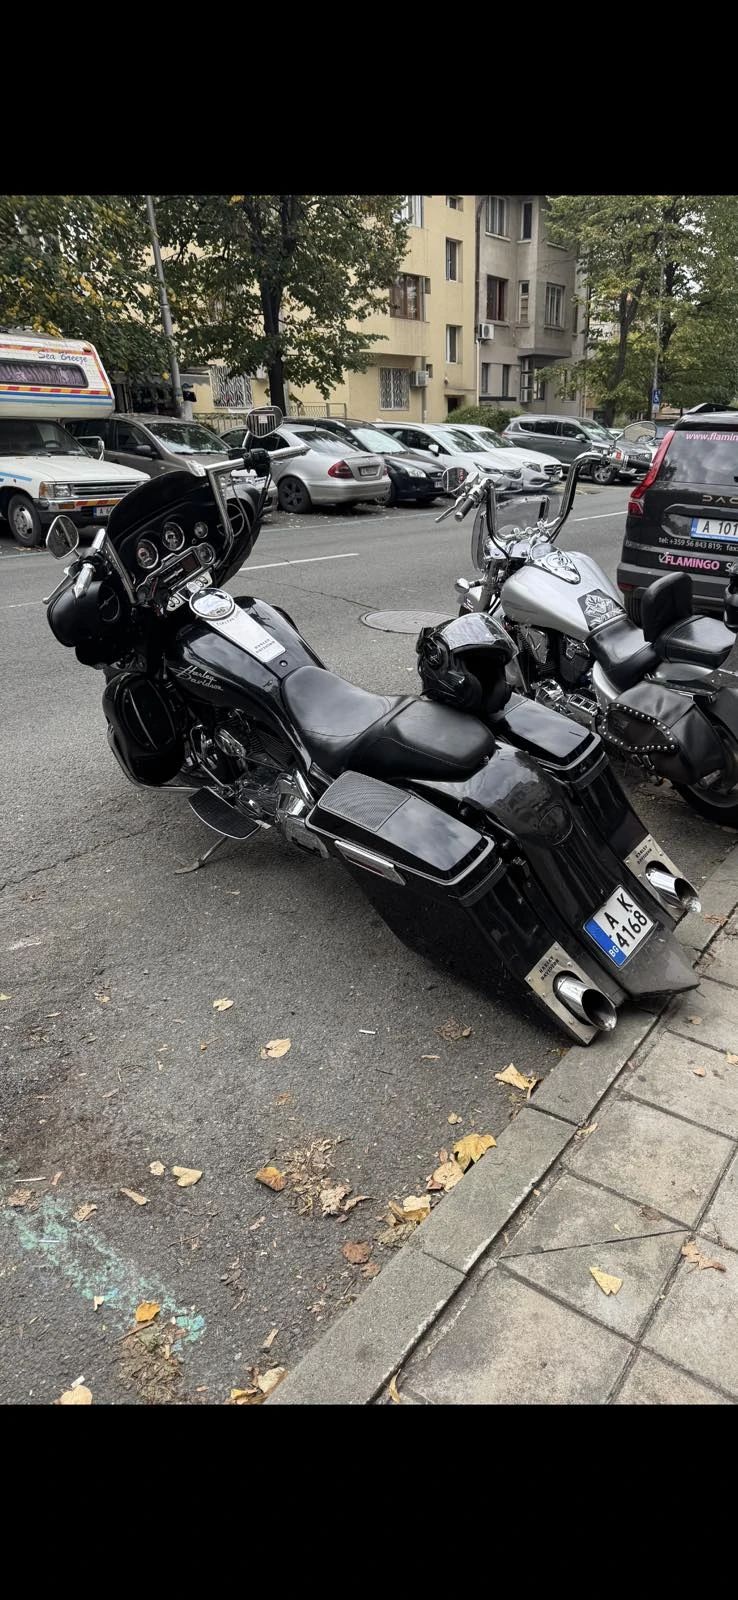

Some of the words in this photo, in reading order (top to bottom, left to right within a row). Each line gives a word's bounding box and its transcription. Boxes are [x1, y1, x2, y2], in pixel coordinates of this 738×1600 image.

[702, 520, 710, 533] A
[669, 538, 685, 546] +359
[694, 541, 707, 549] 843
[175, 670, 224, 691] Davidson
[177, 665, 217, 681] Harley
[604, 911, 619, 929] A
[617, 893, 633, 912] K
[616, 910, 648, 949] 4168
[608, 945, 620, 957] BG
